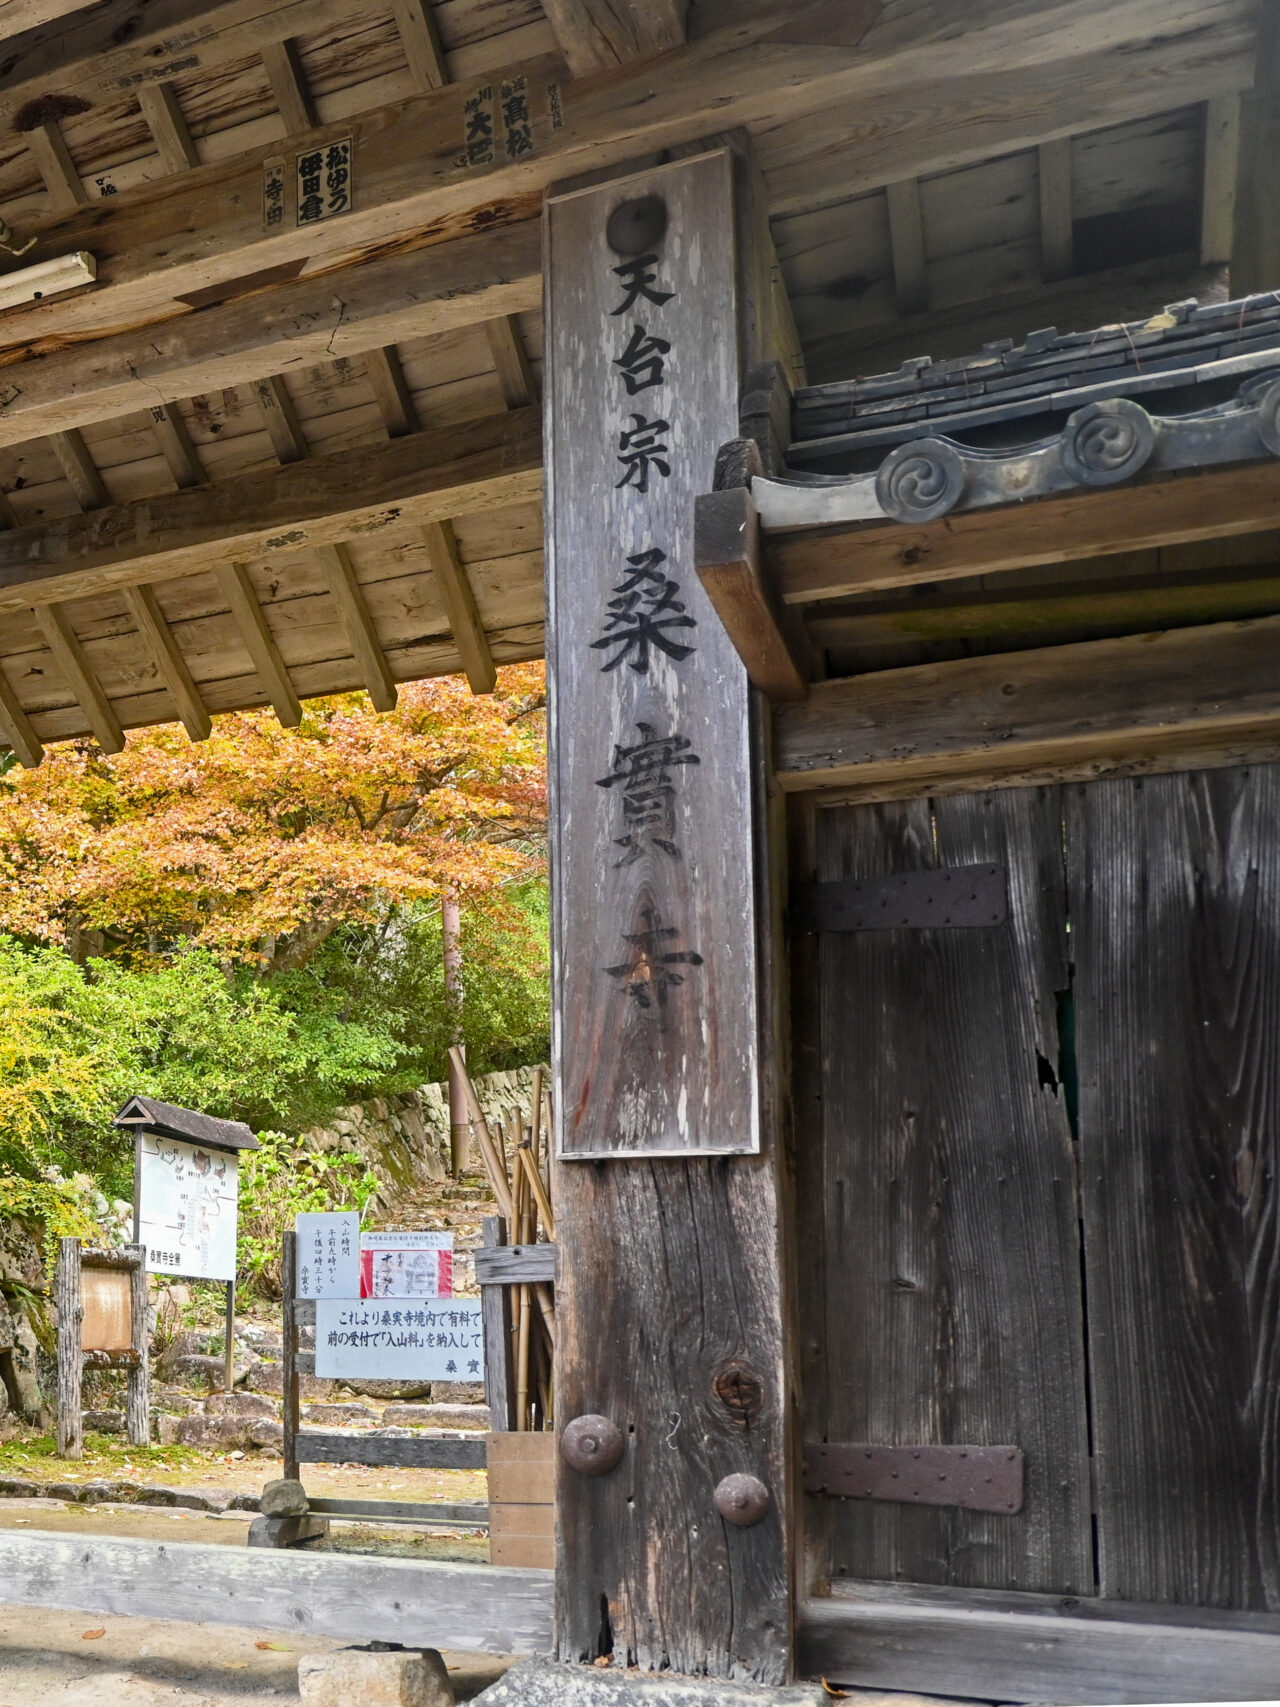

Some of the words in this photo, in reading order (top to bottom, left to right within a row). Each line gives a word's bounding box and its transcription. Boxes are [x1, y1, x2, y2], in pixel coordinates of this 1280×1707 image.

[609, 254, 676, 494] 天台宗
[341, 1219, 350, 1256] 入山時間
